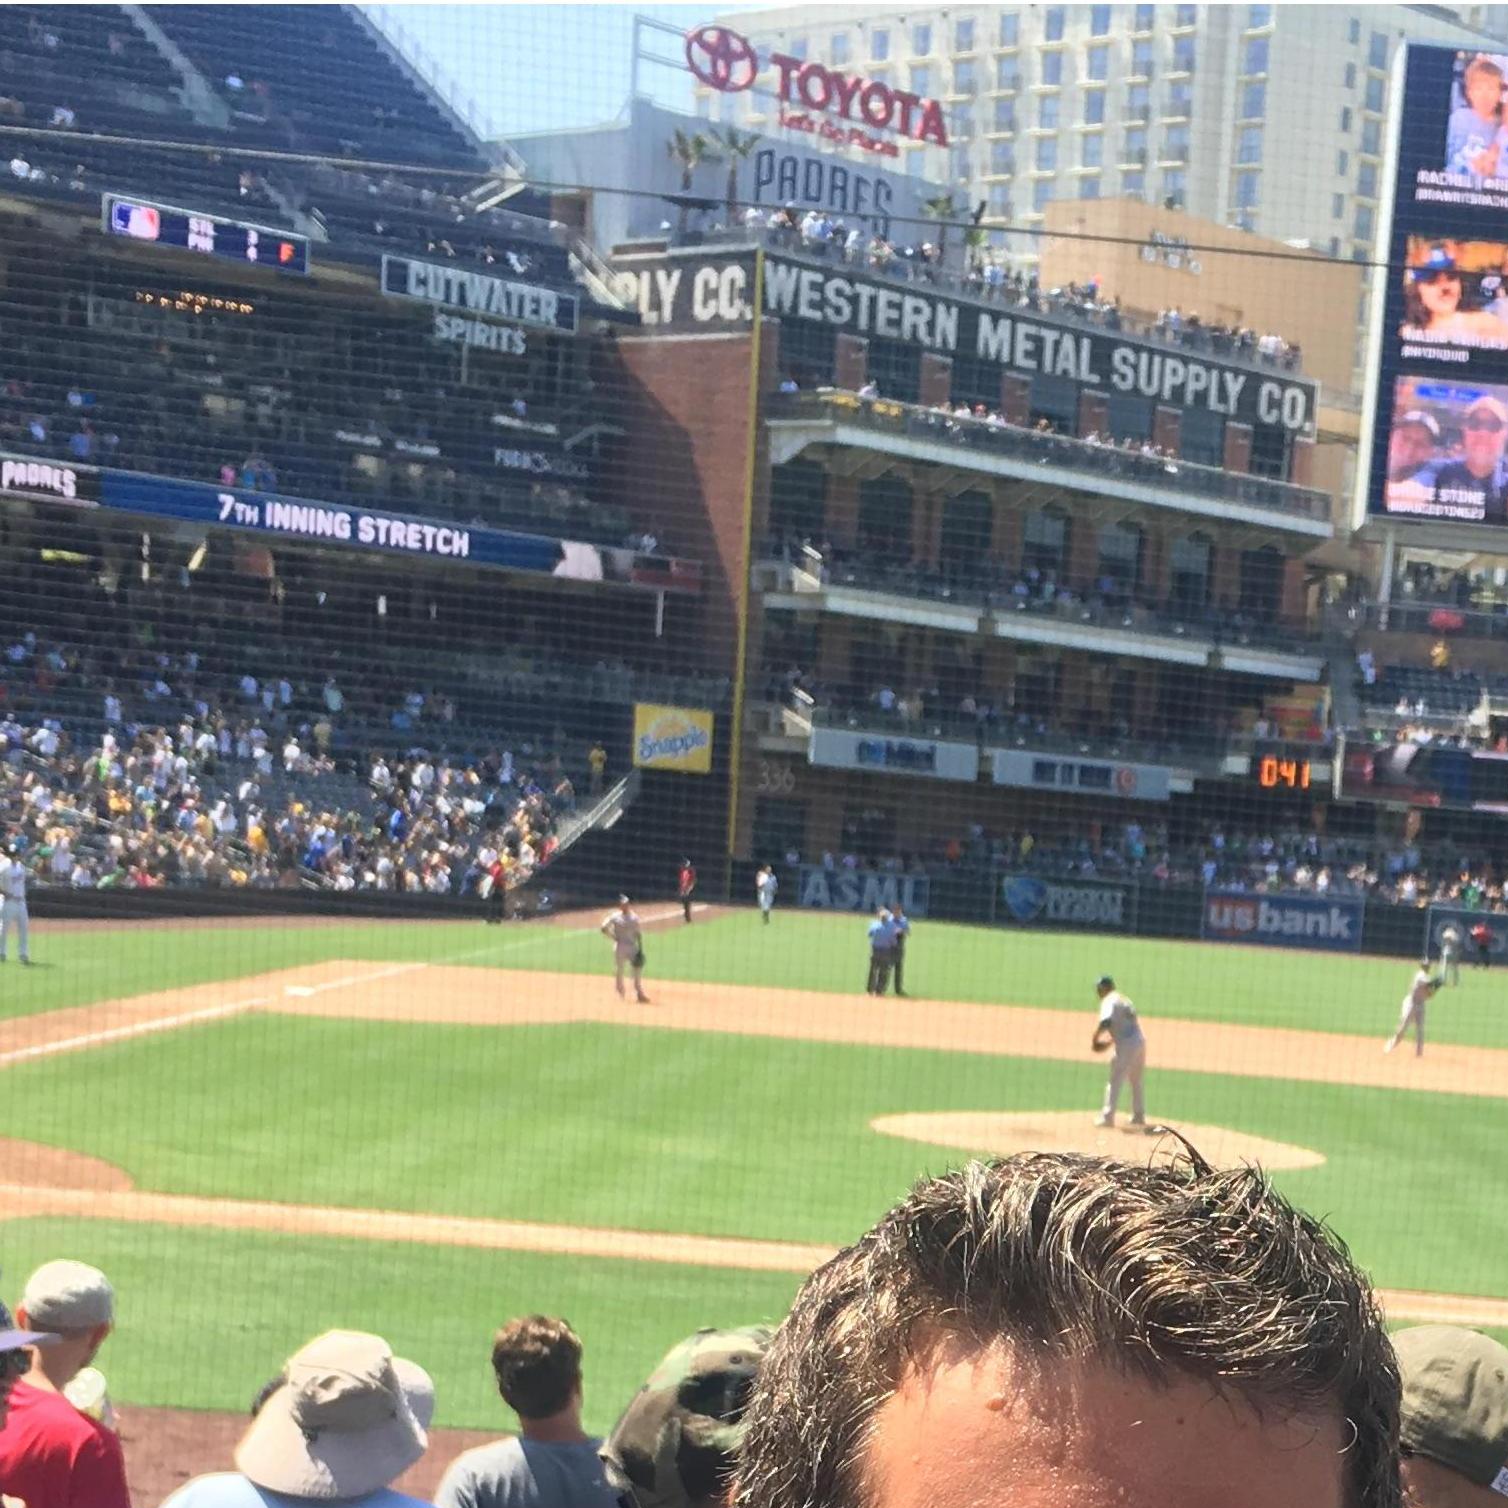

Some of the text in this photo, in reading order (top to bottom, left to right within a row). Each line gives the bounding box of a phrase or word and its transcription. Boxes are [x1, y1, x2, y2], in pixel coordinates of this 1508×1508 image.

[770, 52, 948, 147] TOYOTA
[406, 260, 558, 326] CUTWATER
[693, 265, 753, 322] CO.
[433, 313, 526, 355] SPIRITS
[764, 259, 1313, 432] WESTERN METAL SUPPLY CO.
[265, 501, 351, 540] INNING
[358, 516, 470, 559] STRETCH
